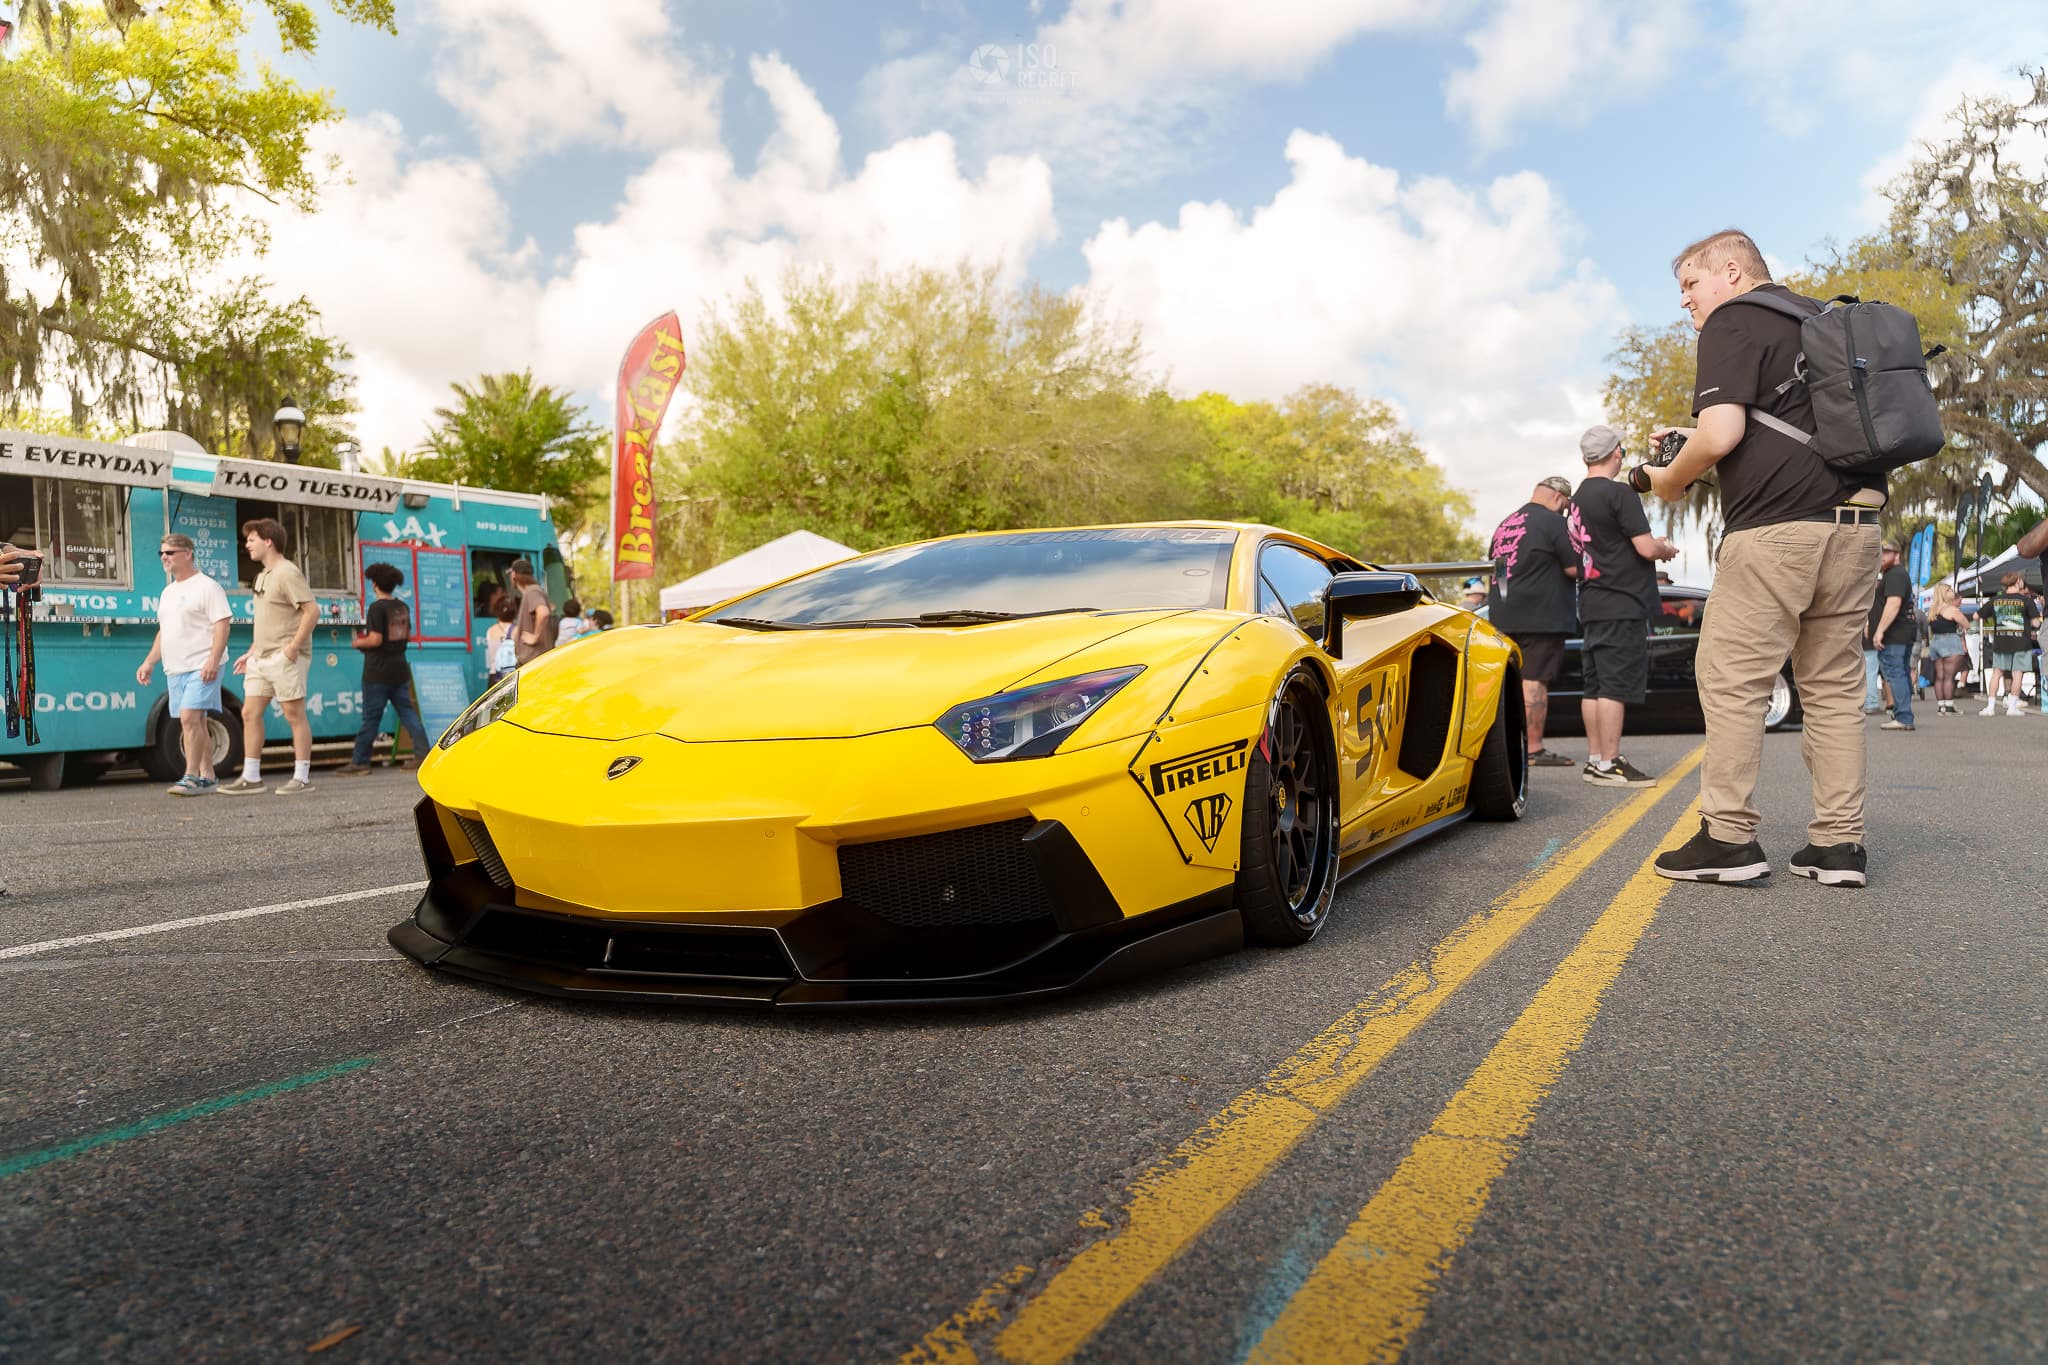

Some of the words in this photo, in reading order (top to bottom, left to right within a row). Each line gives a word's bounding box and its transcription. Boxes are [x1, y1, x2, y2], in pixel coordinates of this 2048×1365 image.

[25, 446, 164, 476] EVERYDAY
[617, 328, 685, 566] Breakfast
[222, 470, 288, 491] TACO
[298, 479, 399, 503] TUESDAY
[179, 515, 227, 528] ORDER
[382, 516, 448, 548] JAX
[1150, 738, 1249, 797] PIRELLI
